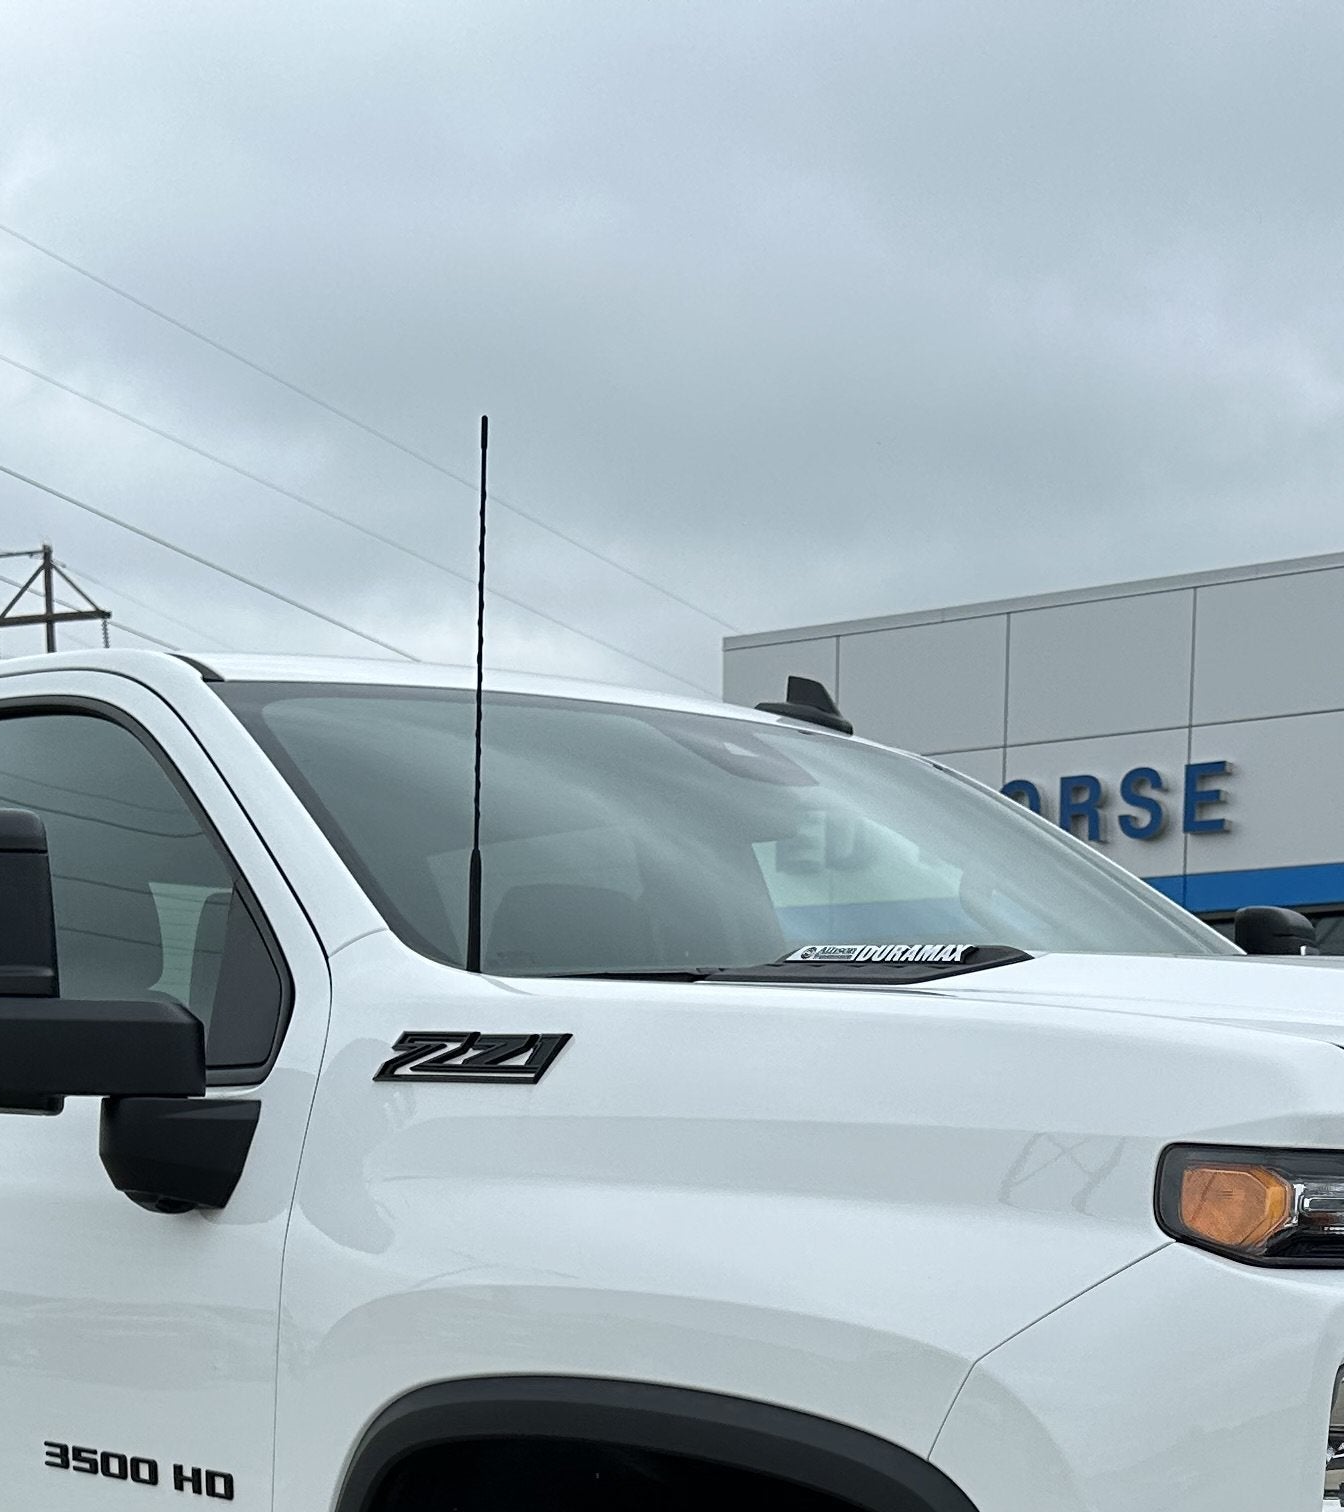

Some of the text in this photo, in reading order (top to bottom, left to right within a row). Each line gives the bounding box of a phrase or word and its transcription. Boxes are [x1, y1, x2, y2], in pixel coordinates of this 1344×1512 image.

[856, 944, 975, 962] DURAMAX
[43, 1440, 235, 1501] 3500 HD
